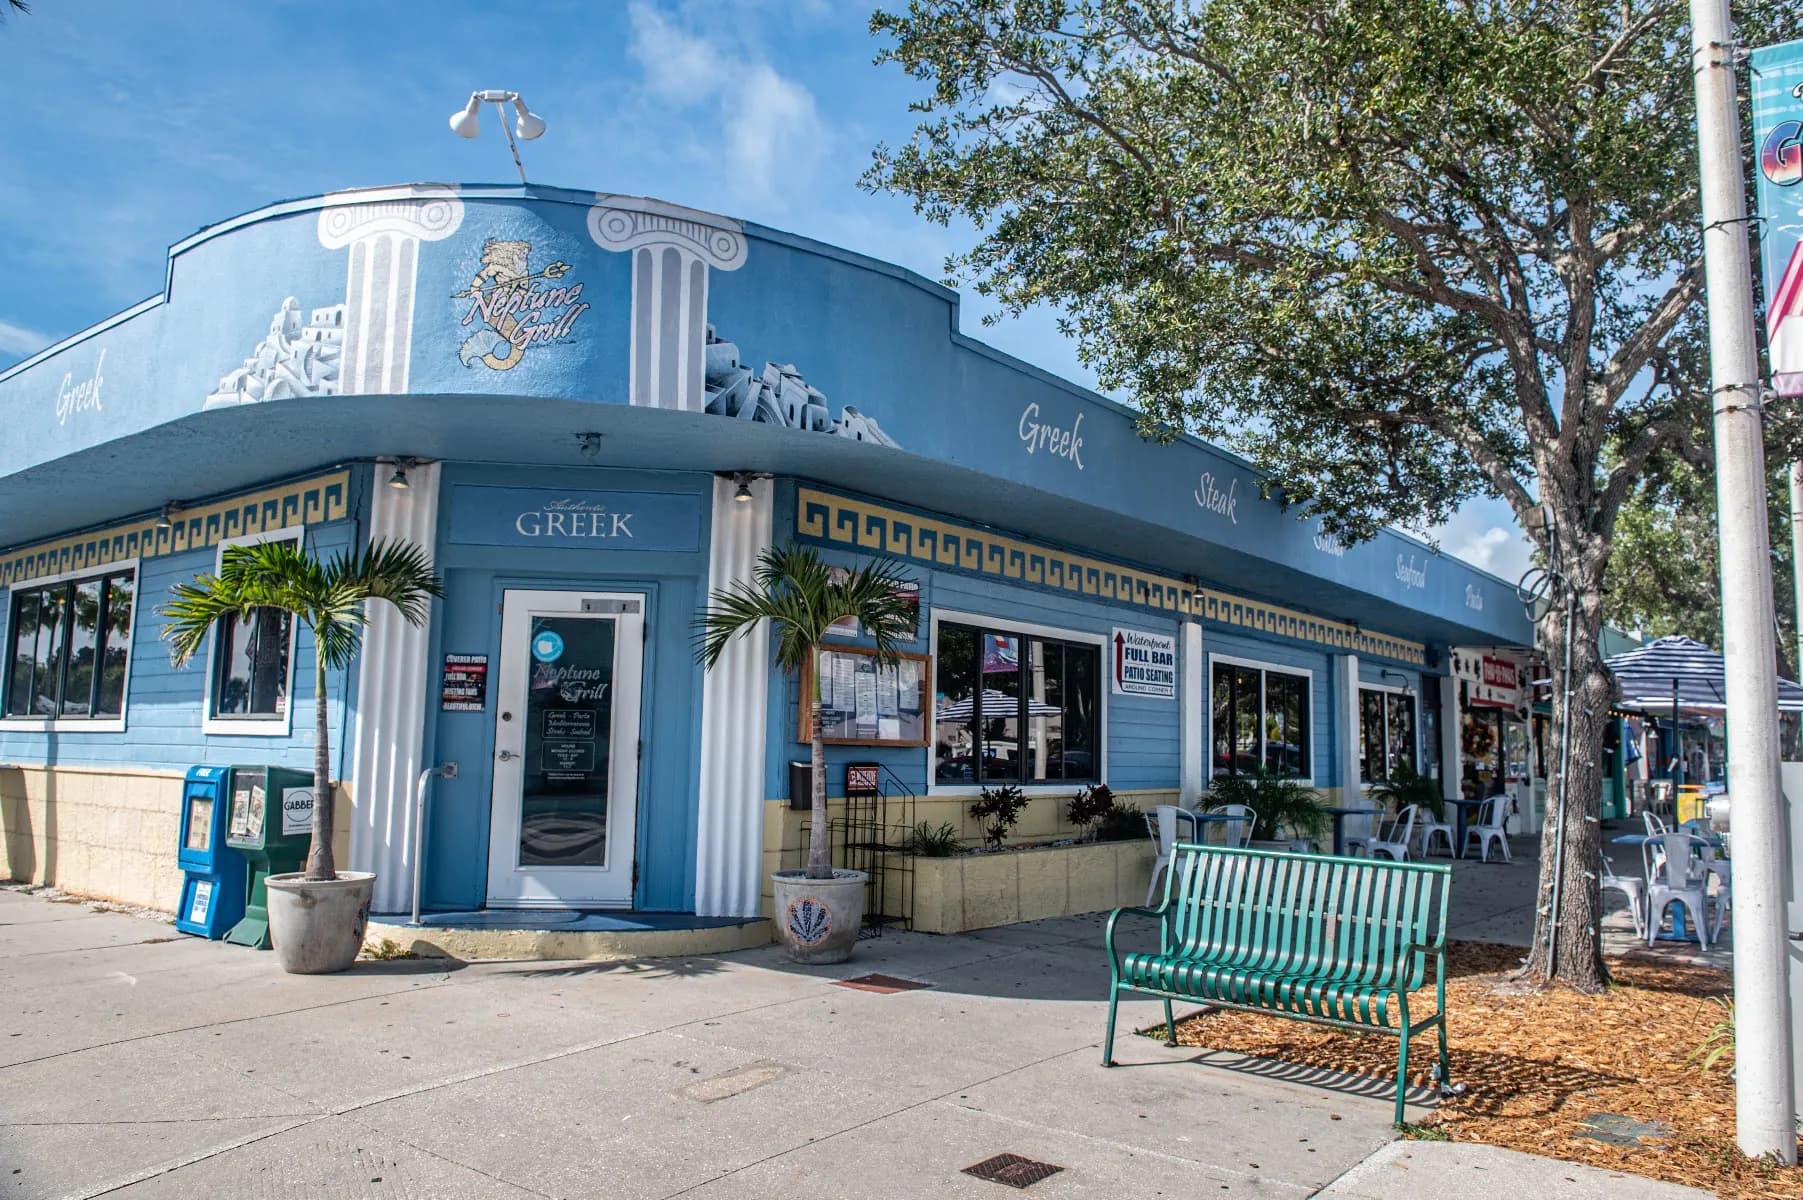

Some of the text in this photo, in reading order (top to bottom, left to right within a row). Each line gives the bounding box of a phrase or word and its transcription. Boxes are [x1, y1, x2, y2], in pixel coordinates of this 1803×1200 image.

[461, 281, 585, 331] Neptune
[509, 303, 591, 350] Grill
[56, 347, 106, 426] Greek
[1019, 402, 1084, 471] Greek
[1194, 471, 1238, 525] Steak
[515, 511, 633, 538] GREEK
[1394, 553, 1428, 591] Seafood
[1125, 647, 1173, 666] FULL BAR
[1126, 632, 1171, 649] Waterfront
[533, 663, 601, 685] Neptune
[1124, 666, 1174, 684] PATIO SEATING
[563, 681, 608, 702] Grill
